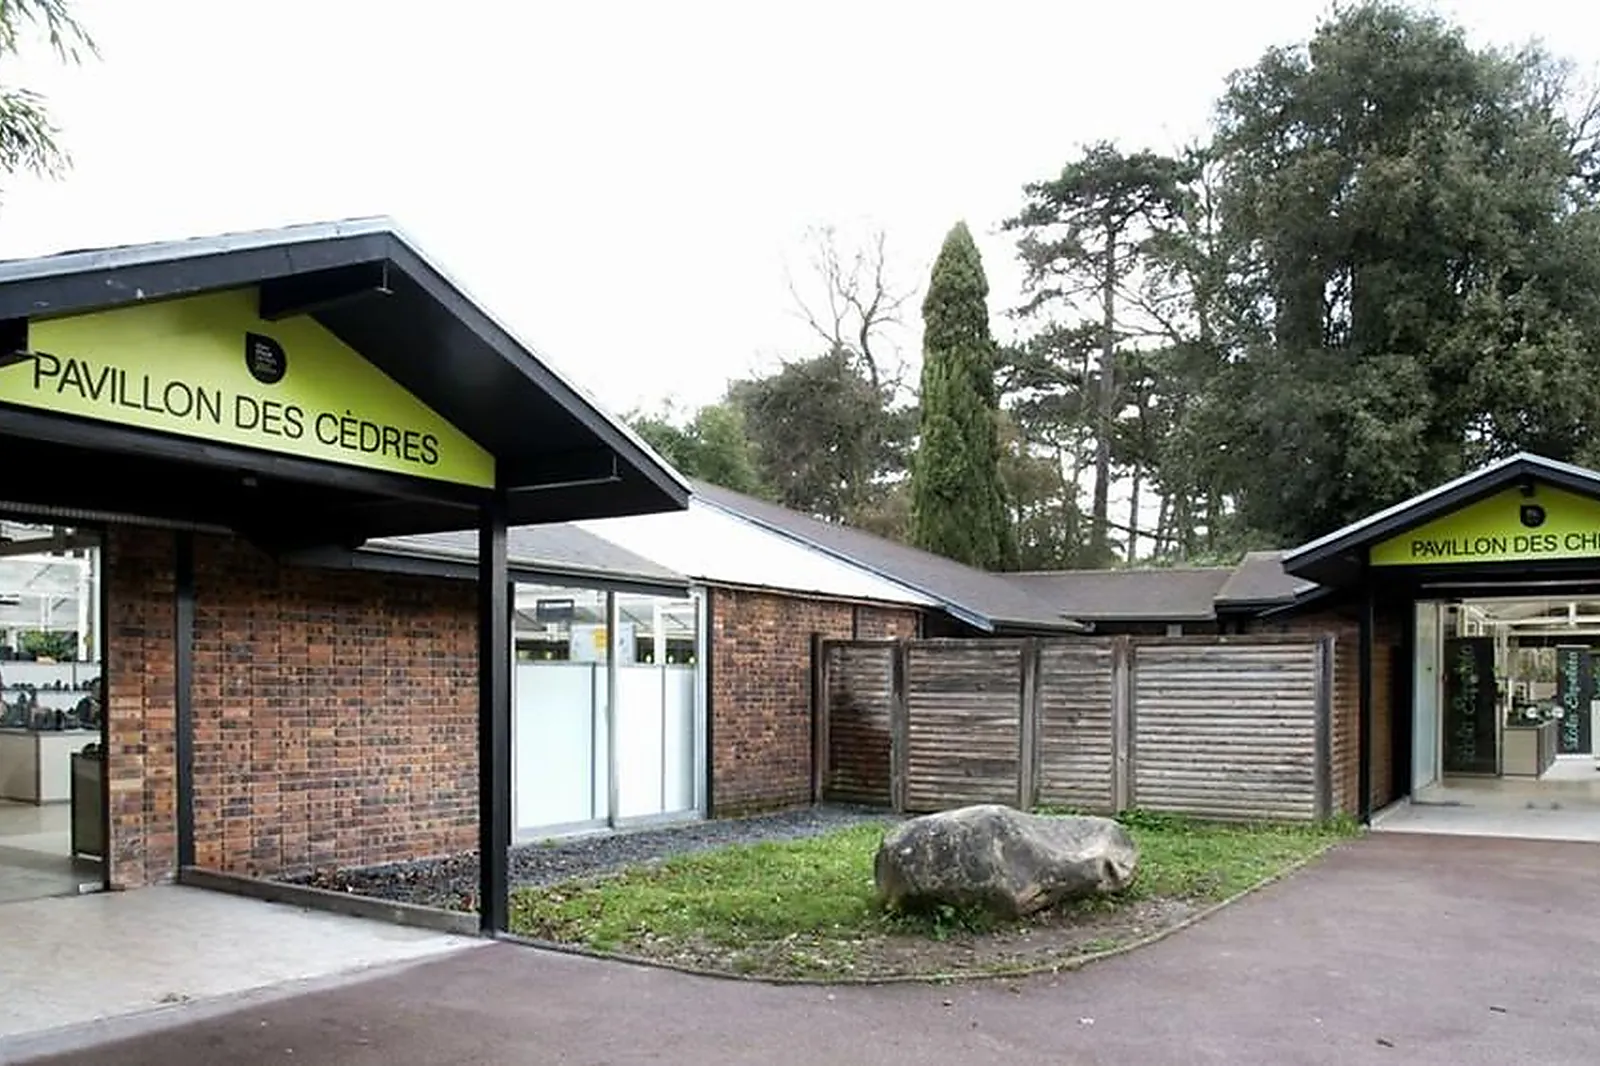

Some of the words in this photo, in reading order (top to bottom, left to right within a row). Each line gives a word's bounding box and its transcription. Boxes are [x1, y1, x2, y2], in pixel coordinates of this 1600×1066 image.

[34, 351, 220, 423] PAVILLON
[235, 395, 304, 439] DES
[315, 410, 439, 465] CÈDRES
[1411, 537, 1507, 556] PAVILLON
[1514, 534, 1557, 553] DES
[1564, 532, 1600, 551] CH
